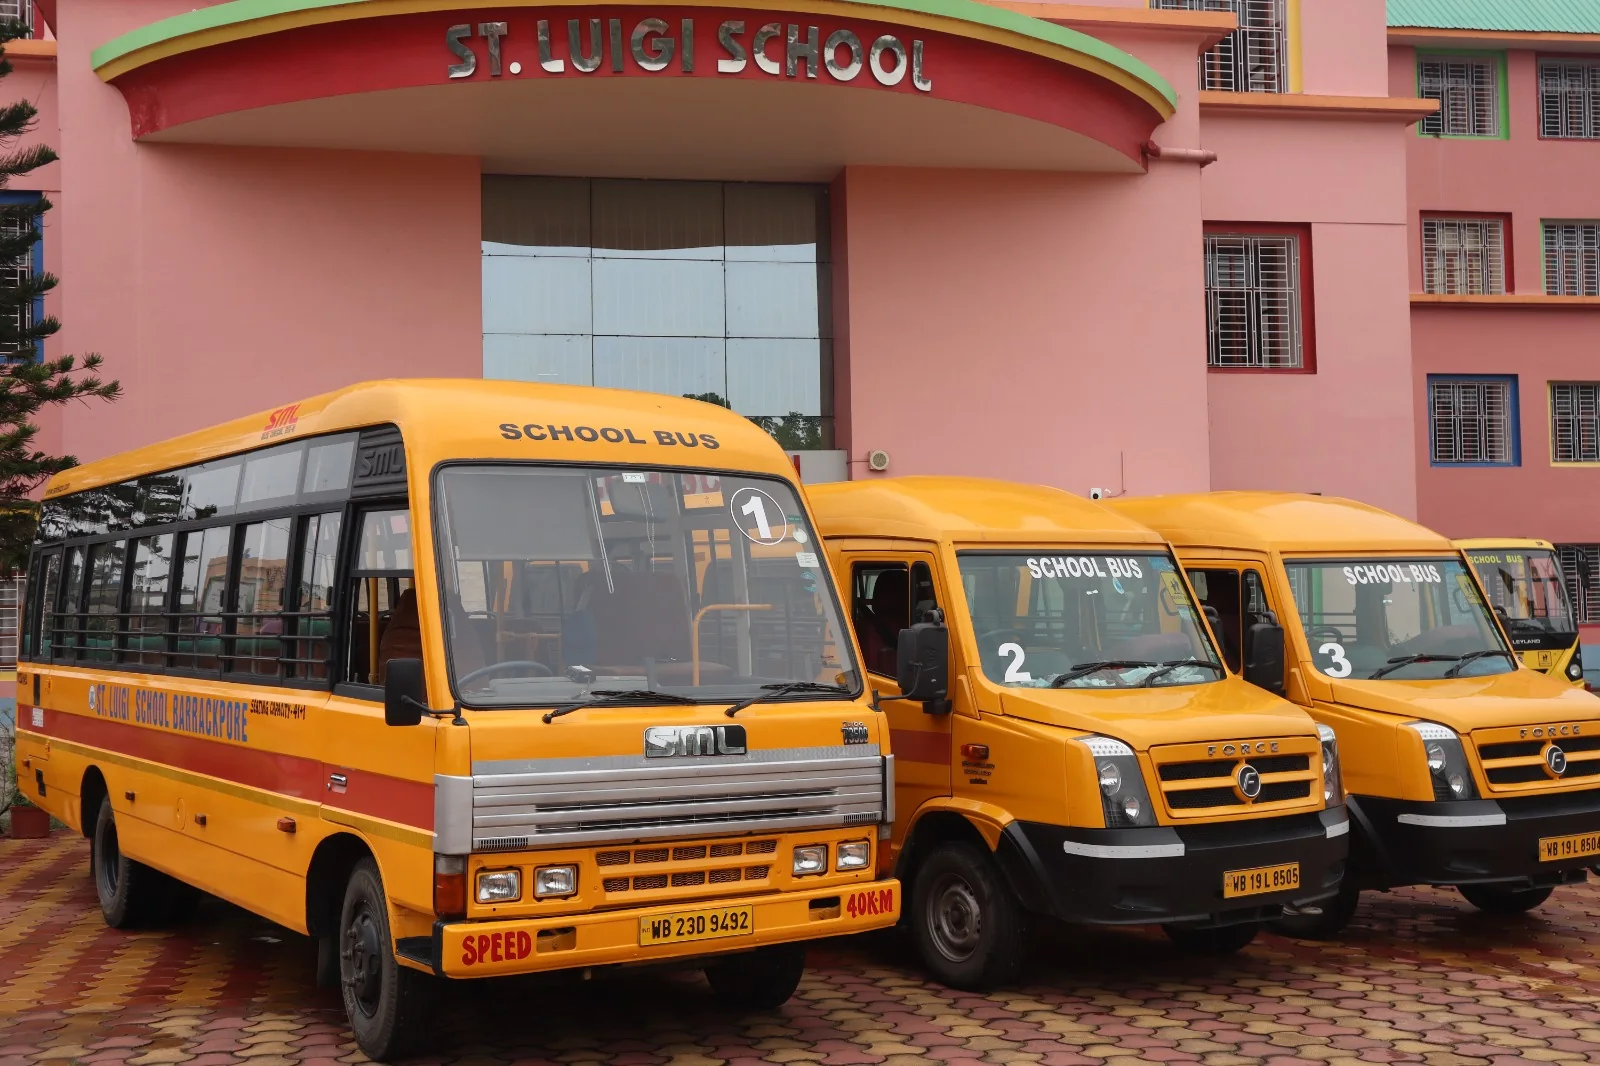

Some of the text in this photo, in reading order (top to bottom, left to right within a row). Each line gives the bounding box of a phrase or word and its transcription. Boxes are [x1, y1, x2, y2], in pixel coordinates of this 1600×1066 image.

[448, 17, 932, 92] ST. LUIGI SCHOOL
[264, 403, 301, 431] SML
[499, 423, 720, 450] SCHOOL BUS
[358, 447, 403, 478] SML
[741, 496, 772, 538] 1
[1026, 557, 1143, 579] SCHOOL BUS
[1468, 555, 1523, 564] SCHOOL BUS
[1343, 564, 1442, 585] SCHOOL BUS
[998, 642, 1032, 683] 2
[1318, 642, 1352, 678] 3
[96, 684, 248, 742] ST. LUIGI SCHOOL BARRACKPORE
[645, 726, 746, 758] SML
[1520, 724, 1580, 739] FORCE
[1208, 742, 1279, 757] FORCE
[1547, 842, 1558, 857] WB
[1562, 840, 1572, 855] 19
[1573, 840, 1578, 854] L
[1233, 867, 1299, 892] WB 19 L 8505
[651, 911, 749, 939] WB 23D 9492
[462, 930, 532, 966] SPEED
